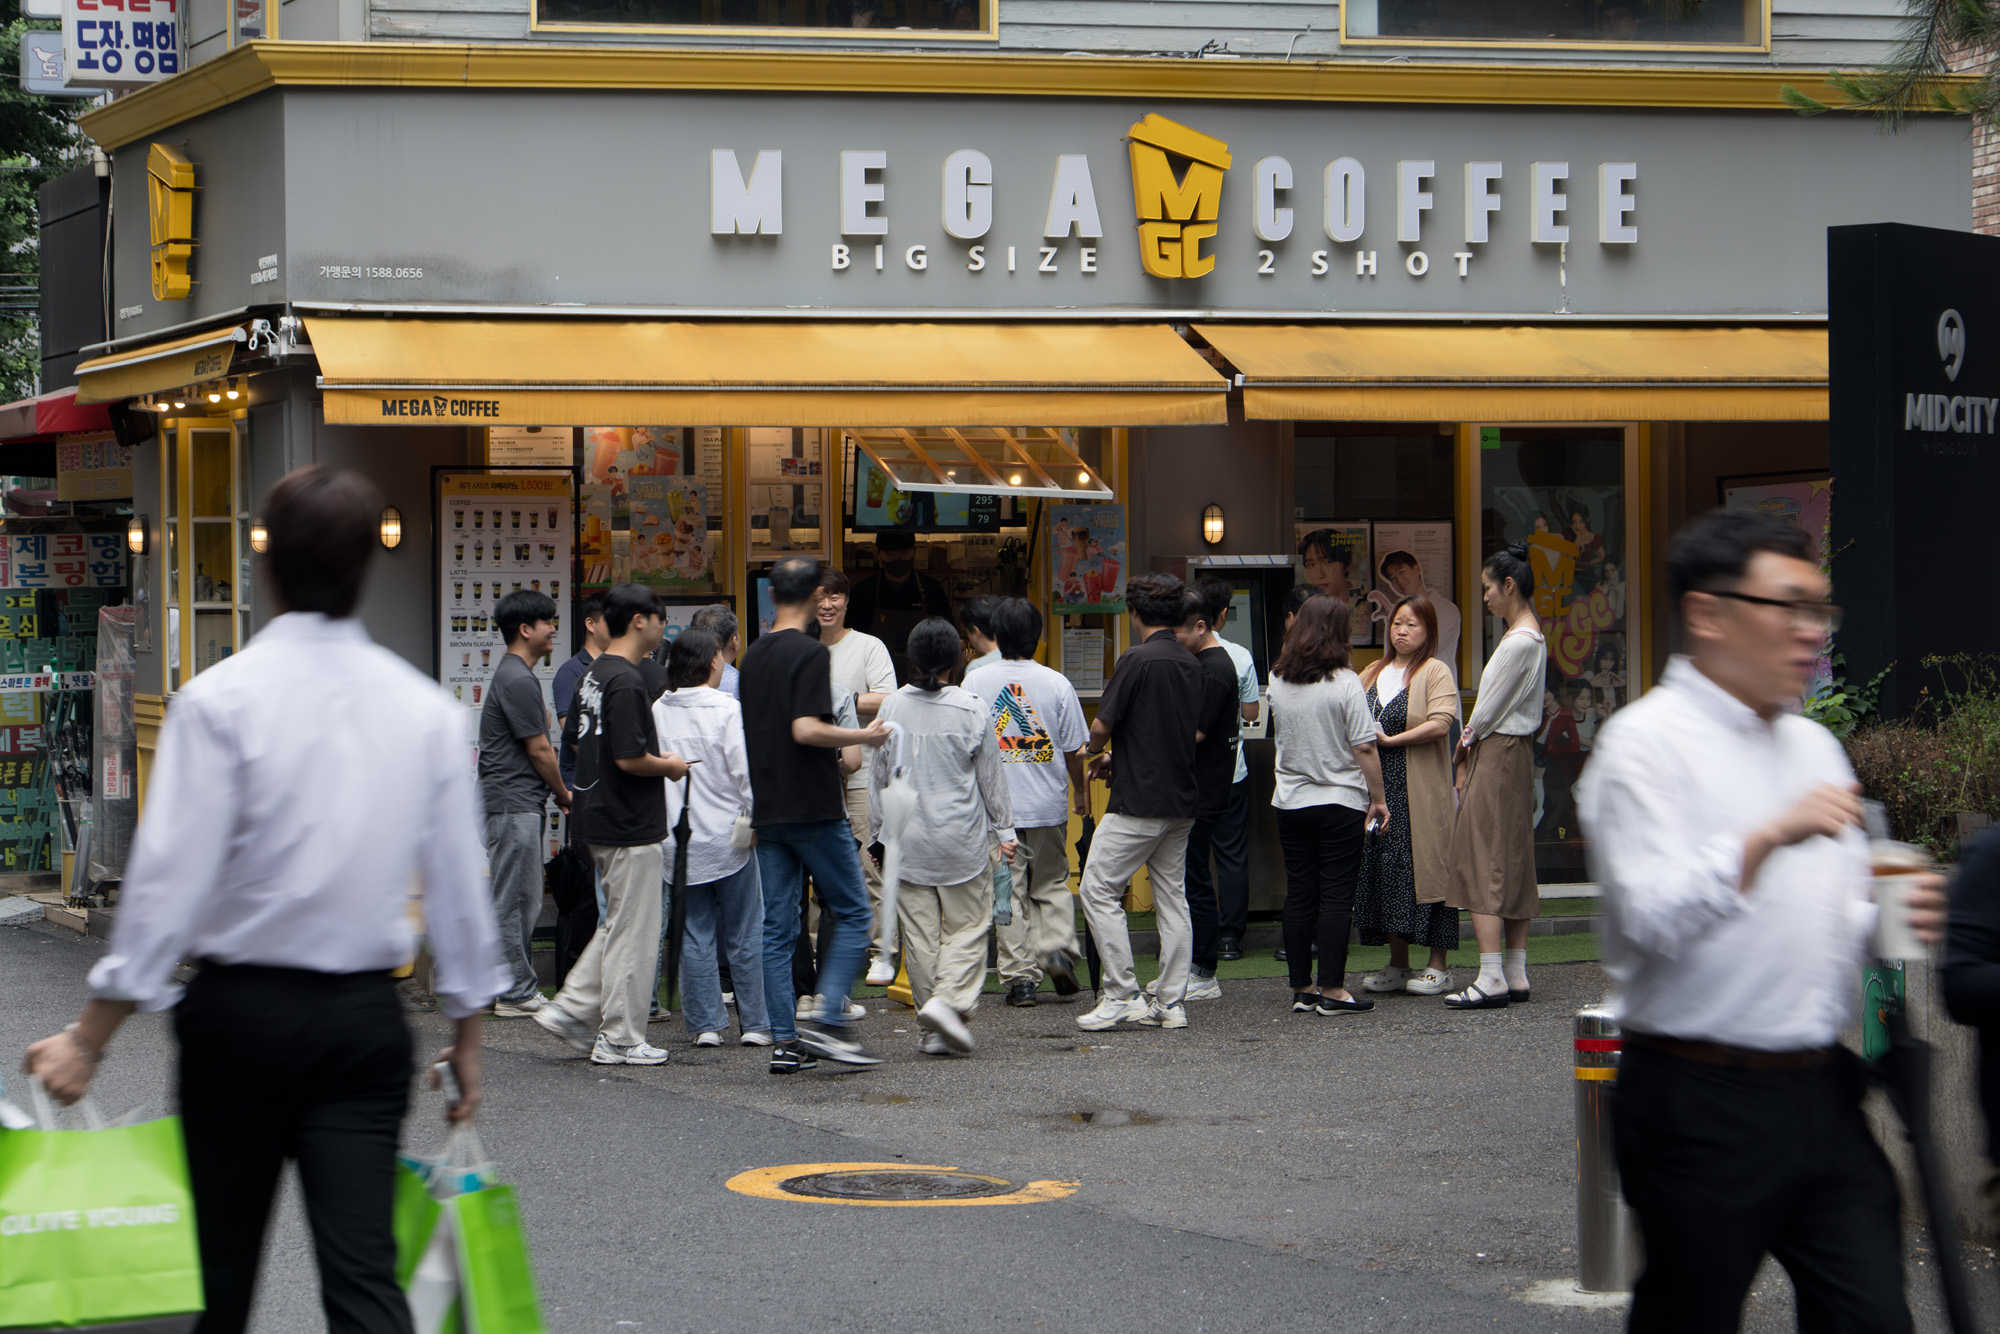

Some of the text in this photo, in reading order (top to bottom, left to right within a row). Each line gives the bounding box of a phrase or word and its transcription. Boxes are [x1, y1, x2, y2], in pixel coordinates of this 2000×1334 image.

[710, 148, 1103, 239] MEGA
[1252, 155, 1638, 244] COFFEE
[319, 265, 423, 279] 가맹문의 1588.0656
[831, 244, 1473, 277] BIG SIZE 2 SHOT
[382, 400, 432, 416] MEGA
[451, 400, 500, 417] COFFEE
[1905, 392, 1999, 435] MIDCITY
[458, 480, 553, 490] 메가 사이즈 아메리카노 1,500원!
[975, 495, 993, 505] 295
[977, 514, 990, 524] 79
[14, 535, 50, 587] 제본
[52, 534, 87, 587] 코팅
[89, 534, 126, 587] 명함
[0, 676, 50, 690] 스마트폰 출력
[0, 1203, 179, 1237] OLIVE YOUNG
